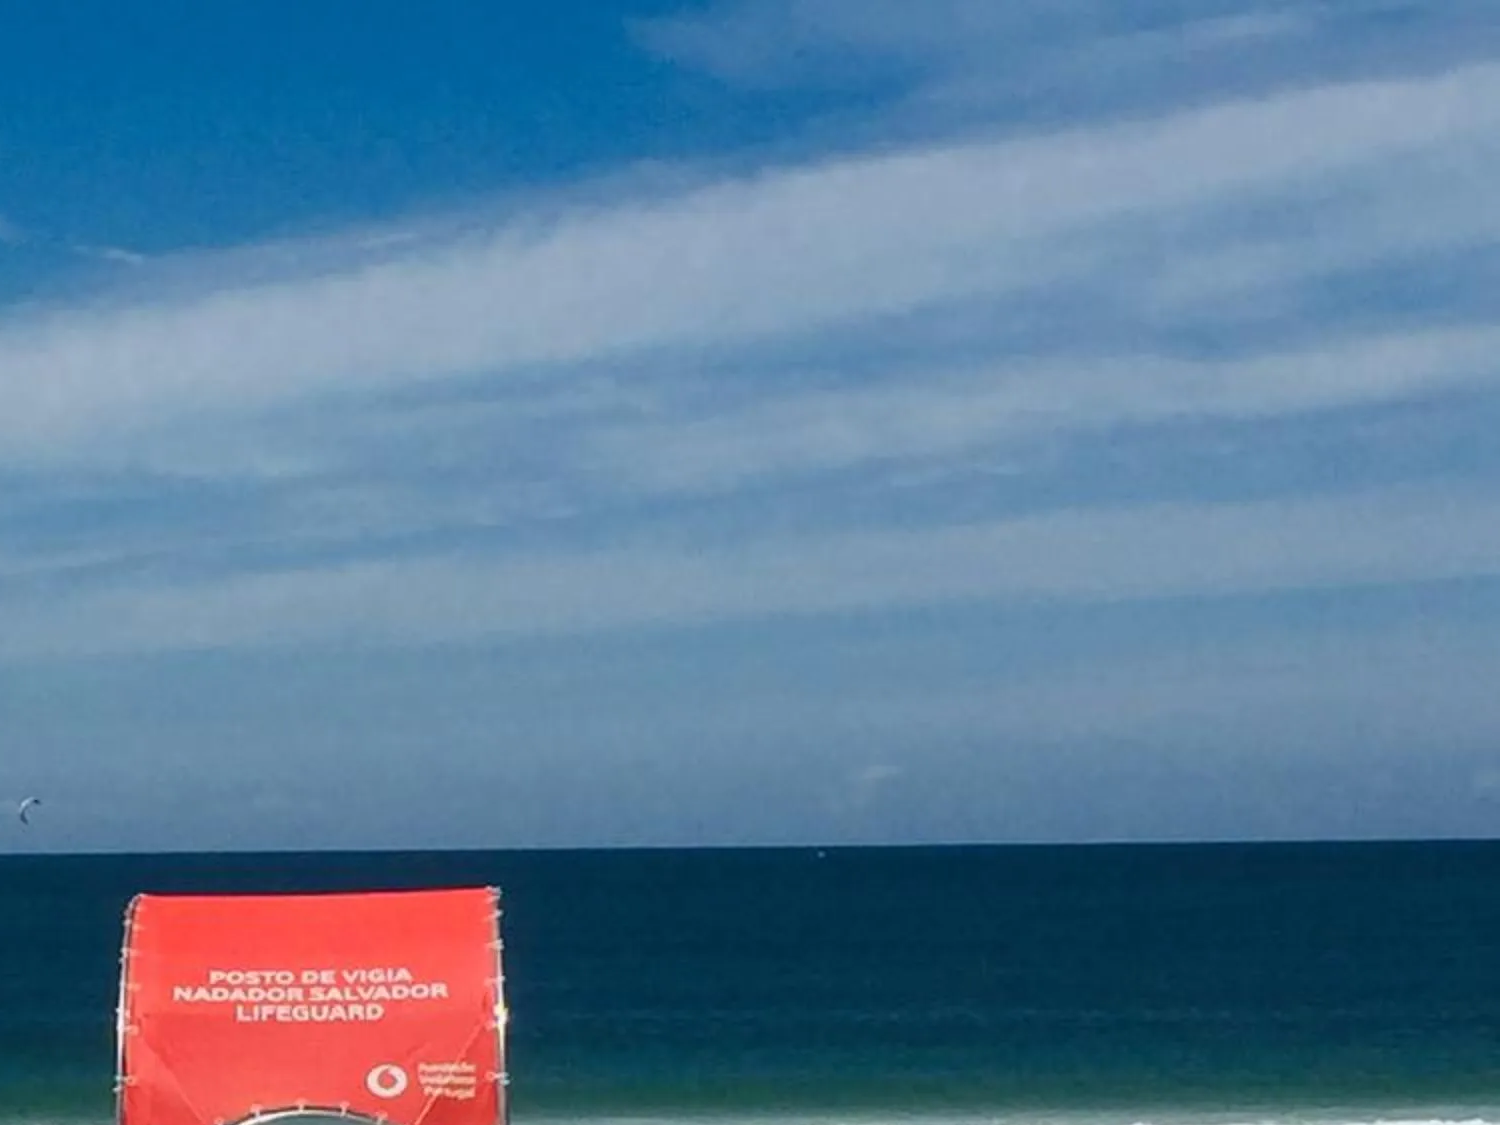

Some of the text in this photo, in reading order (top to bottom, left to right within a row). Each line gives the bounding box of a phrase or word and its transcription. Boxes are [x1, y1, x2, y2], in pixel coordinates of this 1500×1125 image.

[209, 968, 412, 985] POSTO DE VIGIA
[173, 984, 449, 1001] NADADOR SALVADOR
[236, 1004, 384, 1022] LIFEGUARD
